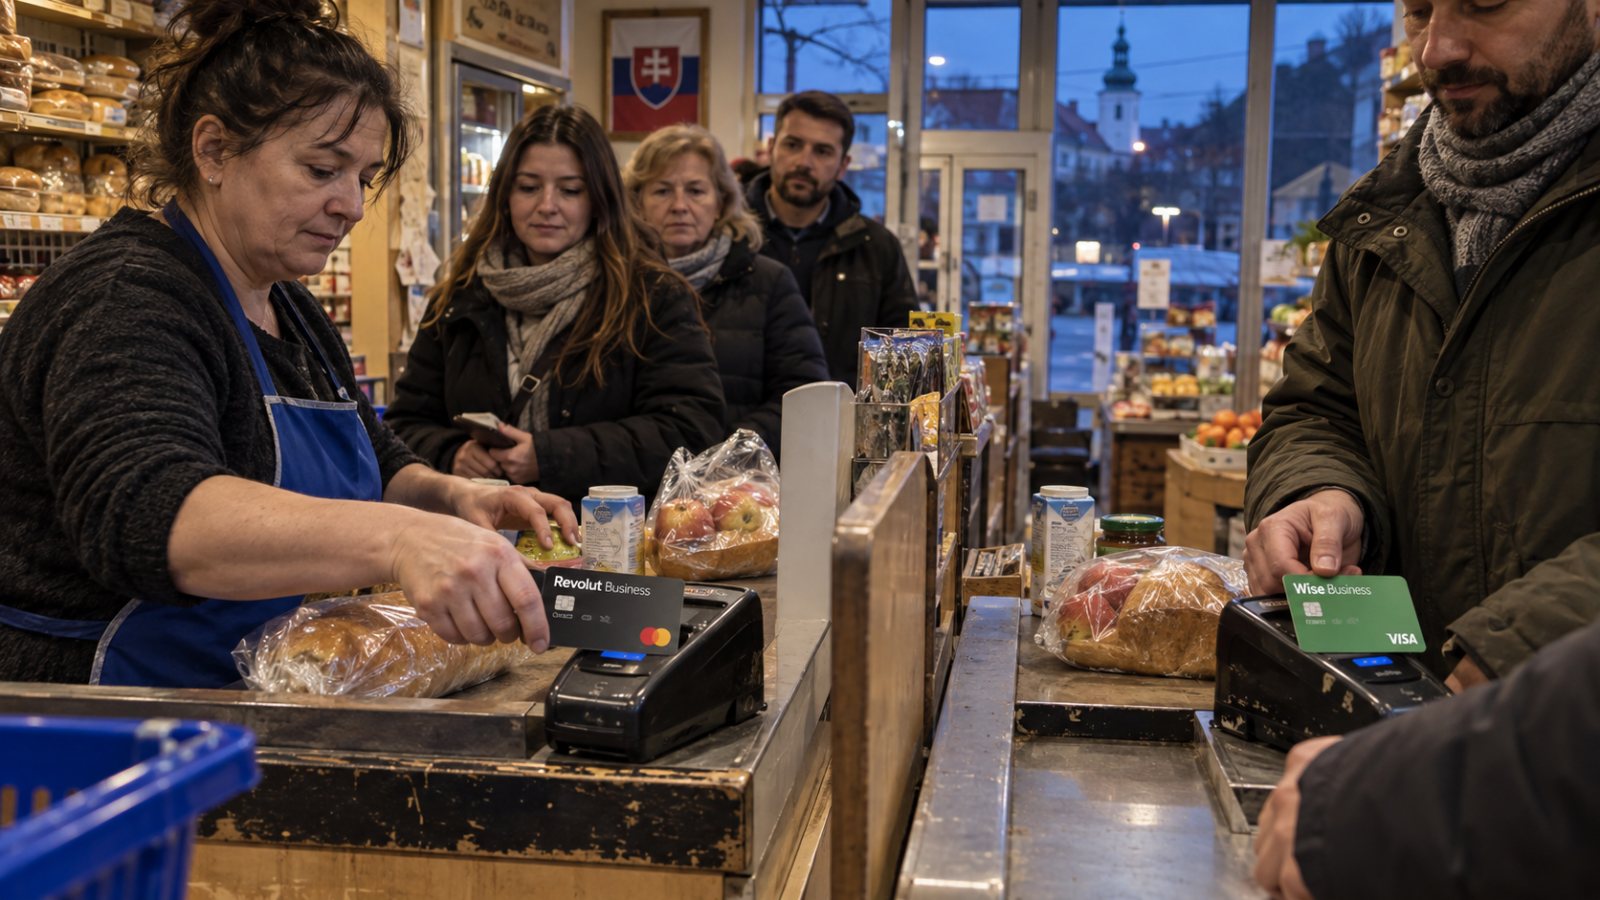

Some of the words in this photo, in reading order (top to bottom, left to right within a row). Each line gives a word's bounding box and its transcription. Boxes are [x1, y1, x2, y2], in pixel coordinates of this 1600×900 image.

[554, 575, 602, 591] Revolut
[605, 581, 651, 597] Business
[1293, 582, 1325, 595] Wise
[1327, 583, 1372, 596] Business
[1386, 633, 1418, 645] VISA
